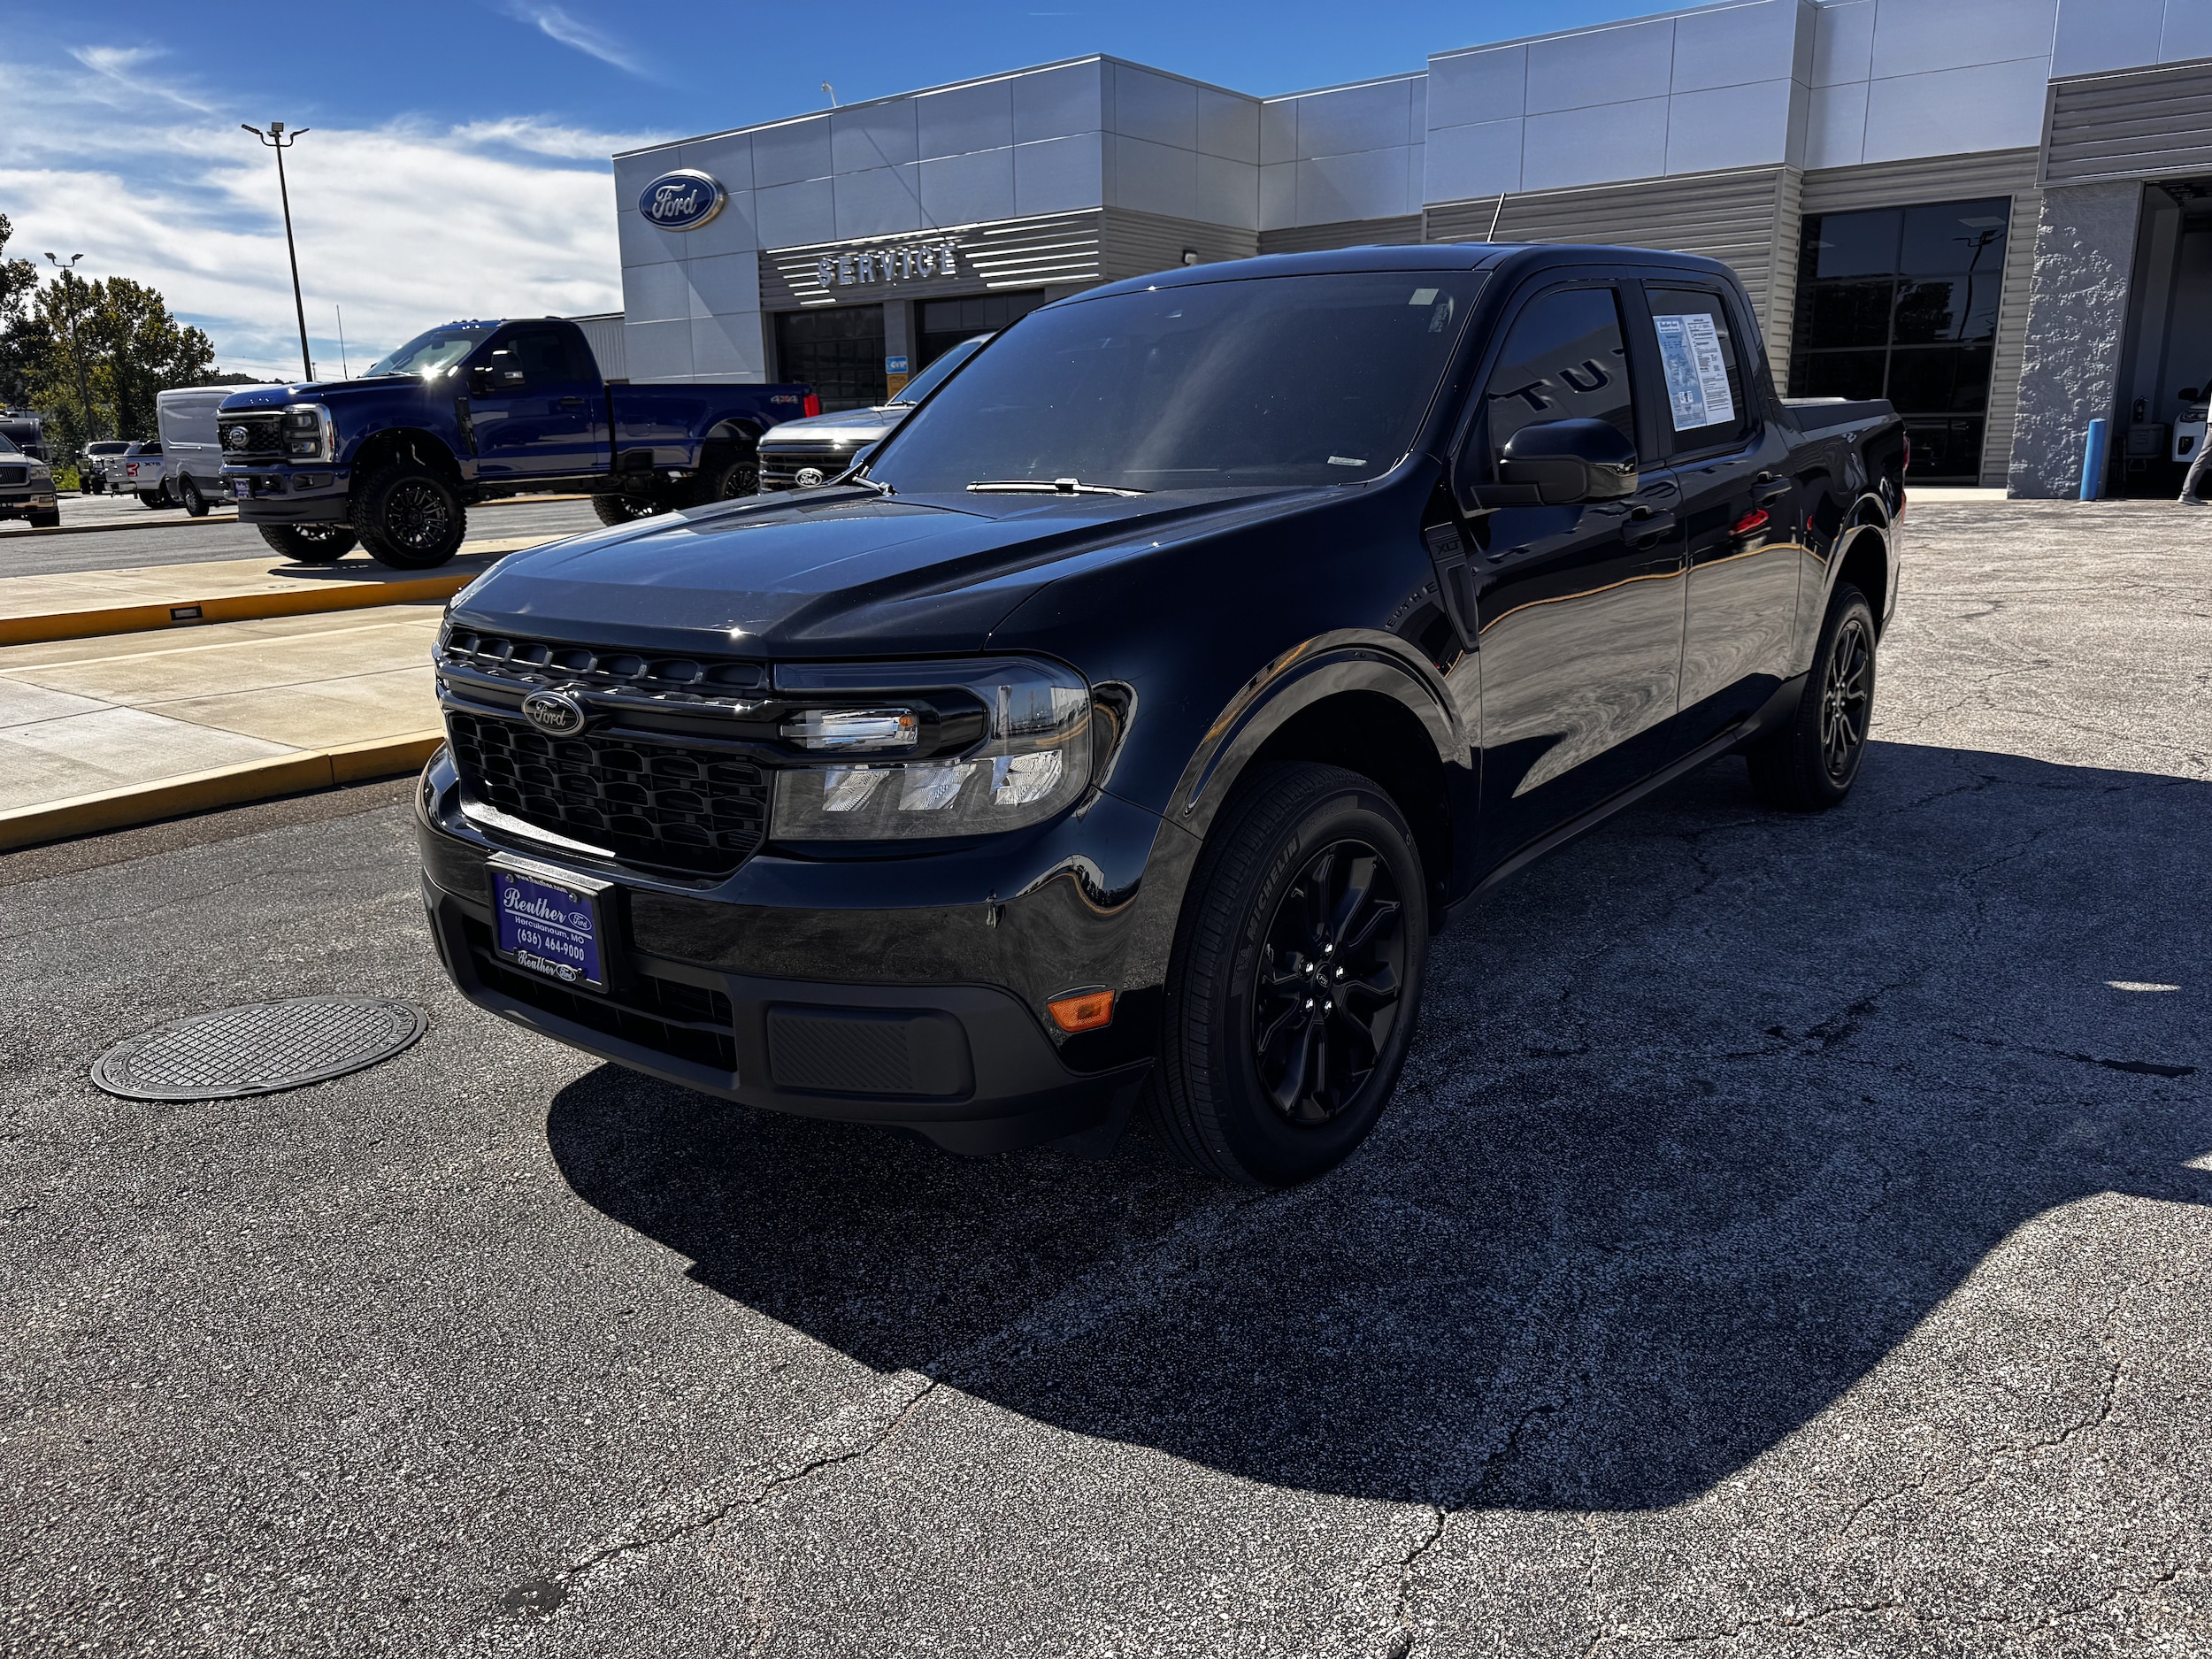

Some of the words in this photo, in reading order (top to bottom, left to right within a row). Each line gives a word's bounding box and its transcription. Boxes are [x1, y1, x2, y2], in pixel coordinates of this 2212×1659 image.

[652, 184, 697, 219] Ford
[818, 243, 956, 287] SERVICE
[1437, 539, 1460, 556] XLT
[534, 700, 566, 726] Ford
[503, 887, 567, 923] Reuther
[1247, 835, 1299, 941] MICHELIN
[517, 928, 541, 949] (636)
[545, 936, 585, 962] 464-9000
[571, 933, 585, 944] MO
[518, 950, 556, 975] Reuther
